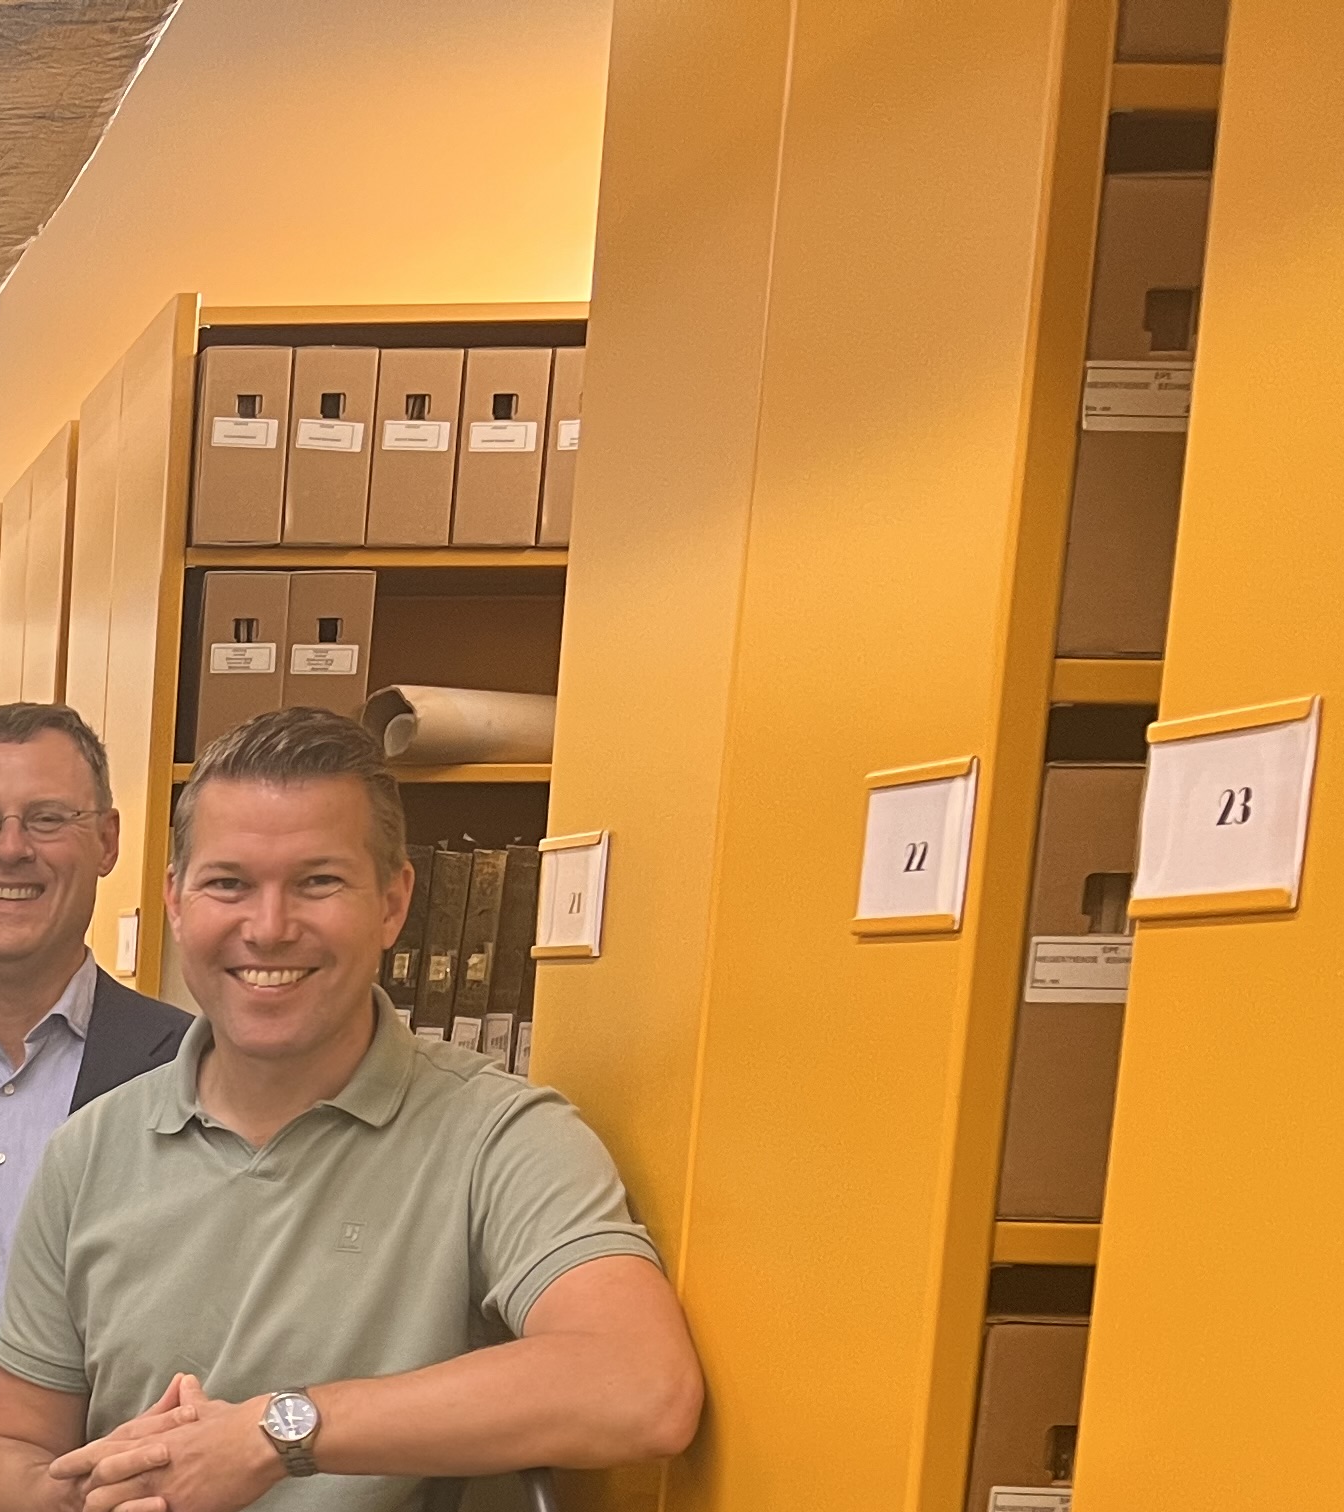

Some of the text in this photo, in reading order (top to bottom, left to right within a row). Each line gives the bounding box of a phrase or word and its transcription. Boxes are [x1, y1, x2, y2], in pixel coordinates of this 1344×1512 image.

[1216, 787, 1252, 826] 23
[903, 842, 928, 872] 22
[568, 892, 582, 914] 21
